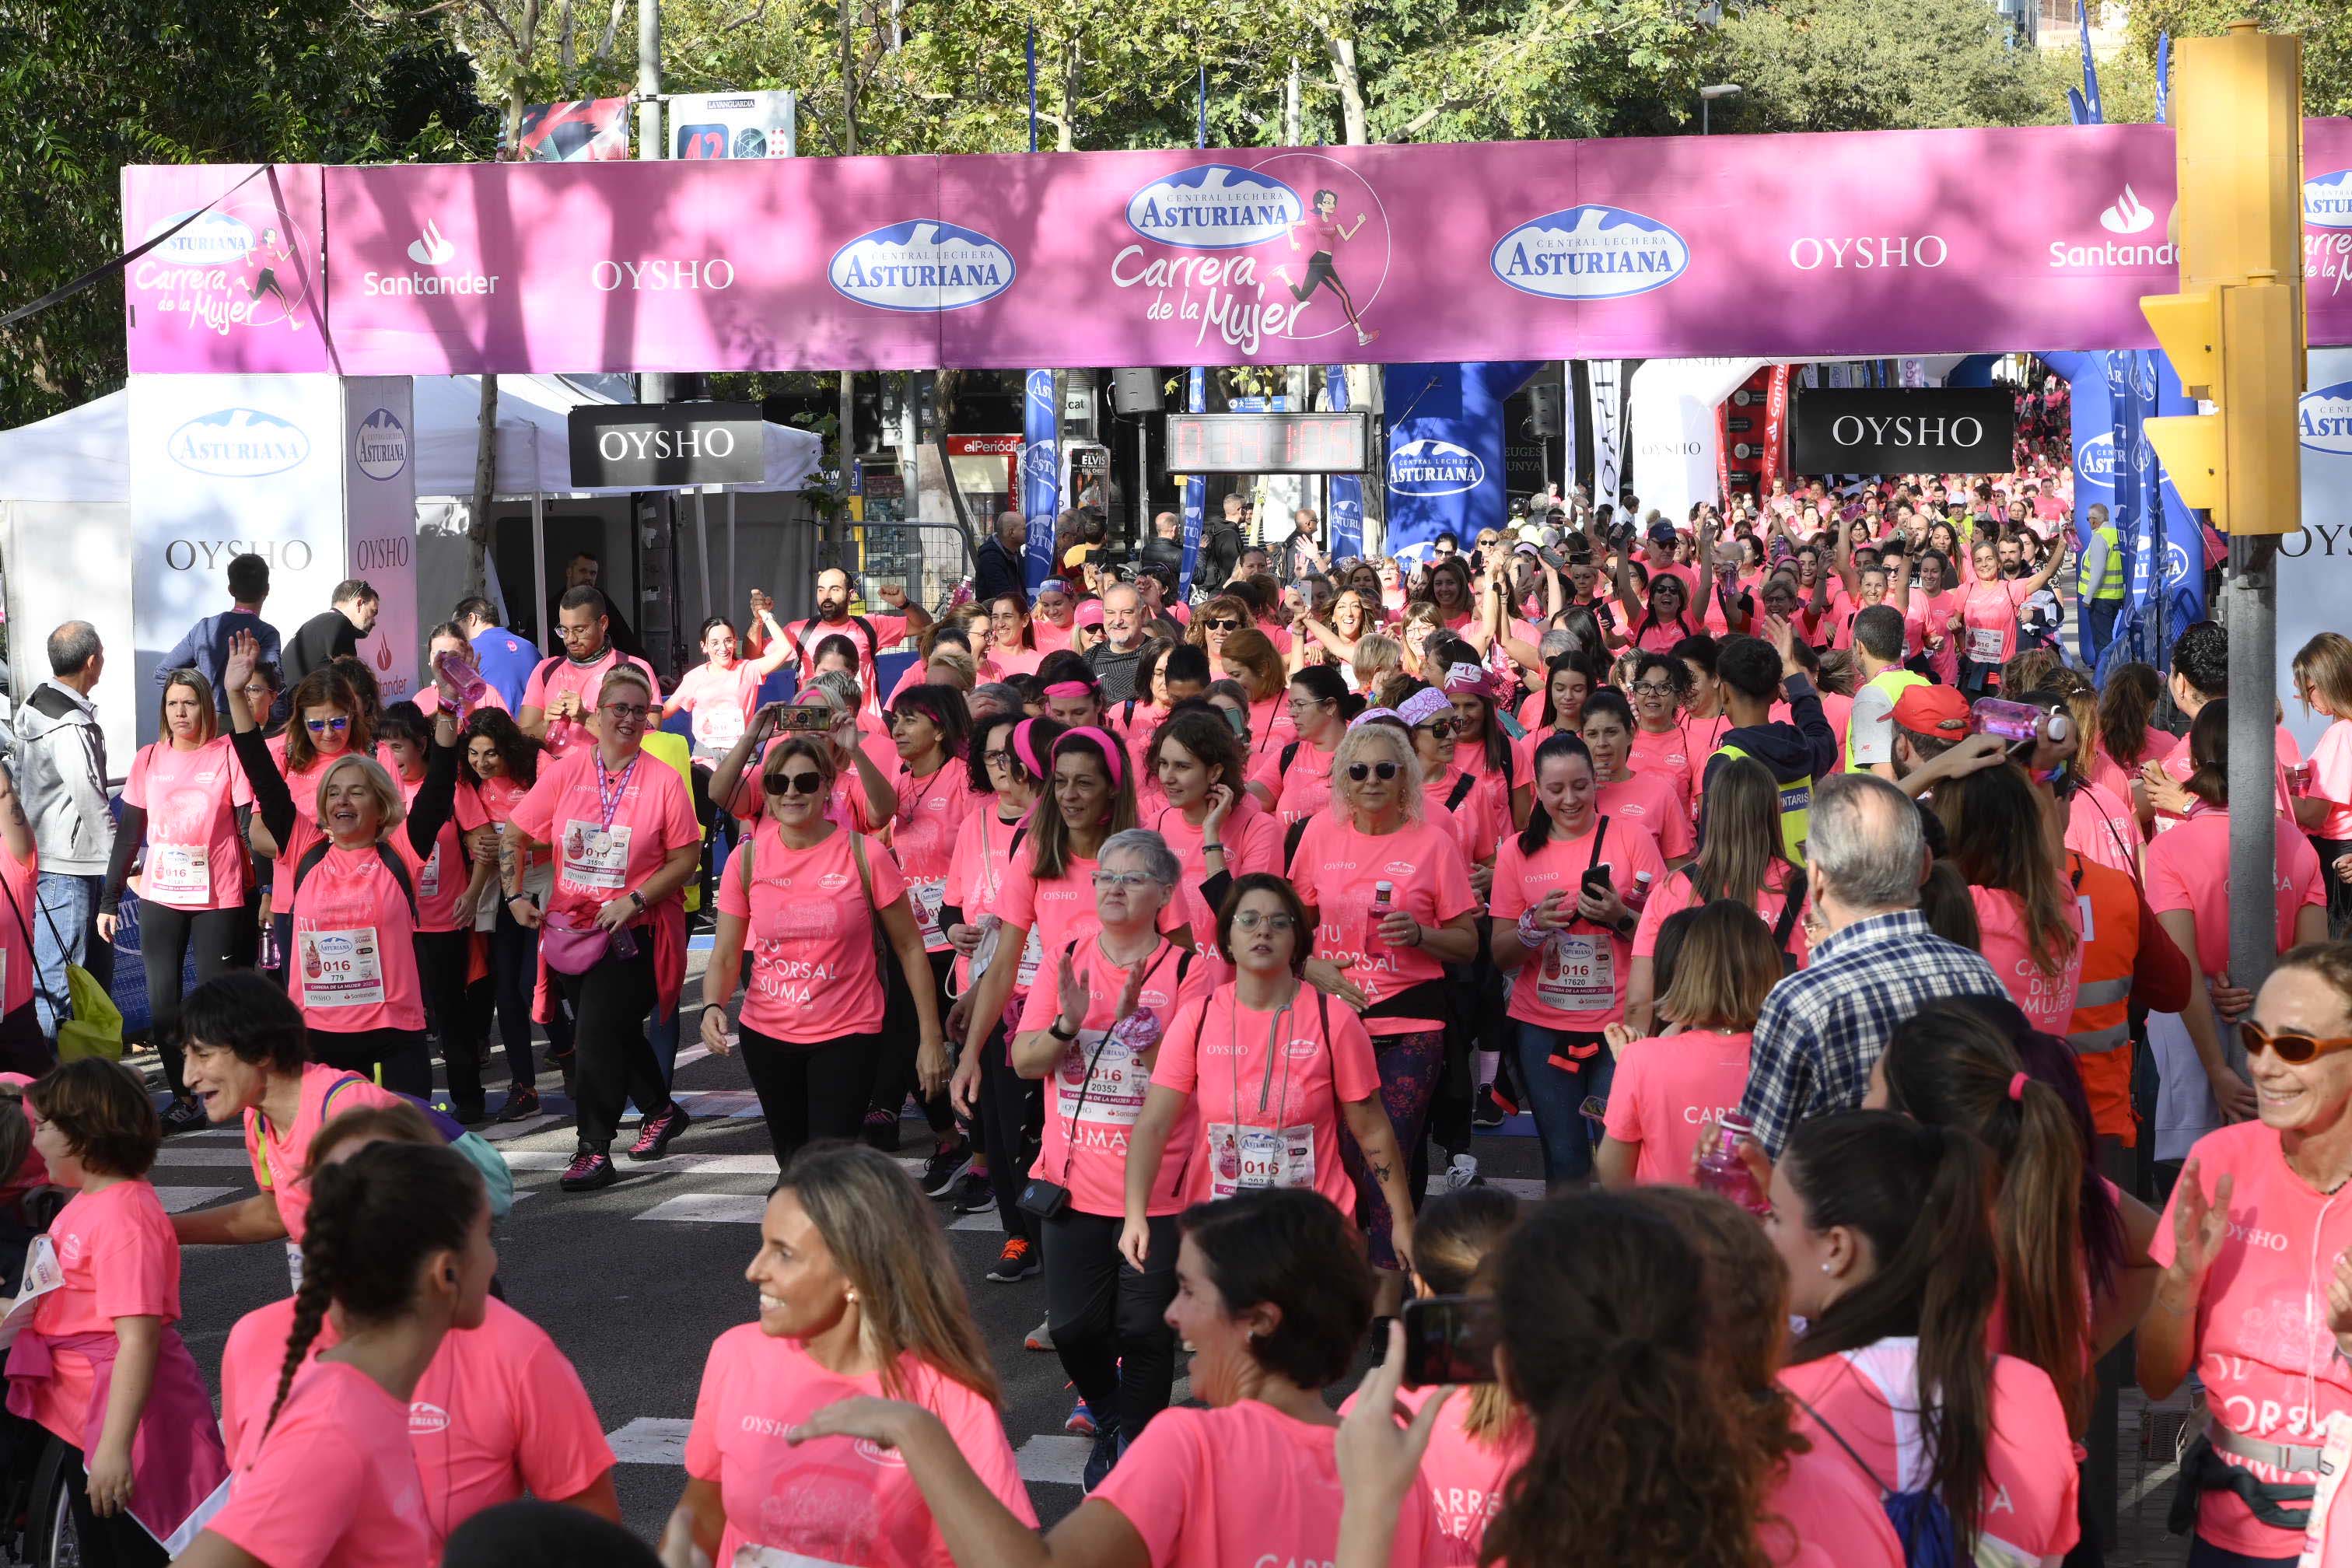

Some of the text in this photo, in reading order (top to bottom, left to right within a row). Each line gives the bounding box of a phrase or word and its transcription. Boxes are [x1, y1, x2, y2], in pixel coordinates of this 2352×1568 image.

[1167, 191, 1284, 202] CENTRAL LECHERA
[1139, 201, 1289, 228] ASTURIANA
[1537, 236, 1668, 248] CENTRAL LECHERA
[870, 250, 996, 261] CENTRAL LECHERA
[1506, 241, 1674, 277] ASTURIANA
[1790, 235, 1948, 270] OYSHO
[136, 260, 226, 291] Carrera
[591, 258, 735, 292] OYSHO
[843, 254, 1002, 289] ASTURIANA
[1111, 244, 1258, 289] Carrera
[364, 271, 499, 296] Santander
[189, 286, 262, 336] Mujer
[1146, 283, 1311, 355] de la Mujer
[1832, 415, 1983, 447] OYSHO
[179, 433, 300, 460] ASTURIANA
[359, 440, 404, 464] ASTURIANA
[600, 428, 734, 461] OYSHO
[1081, 455, 1105, 465] ELVIS
[1389, 463, 1477, 484] ASTURIANA
[357, 536, 409, 572] OYSHO
[1282, 810, 1301, 825] TU
[1324, 861, 1356, 870] OYSHO
[1524, 872, 1559, 884] OYSHO
[1043, 891, 1077, 901] OYSHO
[929, 908, 940, 918] 01
[1321, 923, 1341, 943] TU
[324, 961, 351, 971] 016
[760, 957, 837, 980] DORSAL
[1562, 964, 1589, 975] 016
[759, 975, 812, 1003] SUMA
[1206, 1045, 1248, 1055] OYSHO
[1091, 1068, 1122, 1082] 016
[1091, 1083, 1118, 1094] 20352
[1063, 1104, 1092, 1114] OYHO
[1110, 1096, 1131, 1104] MUJER
[1244, 1160, 1279, 1174] 016
